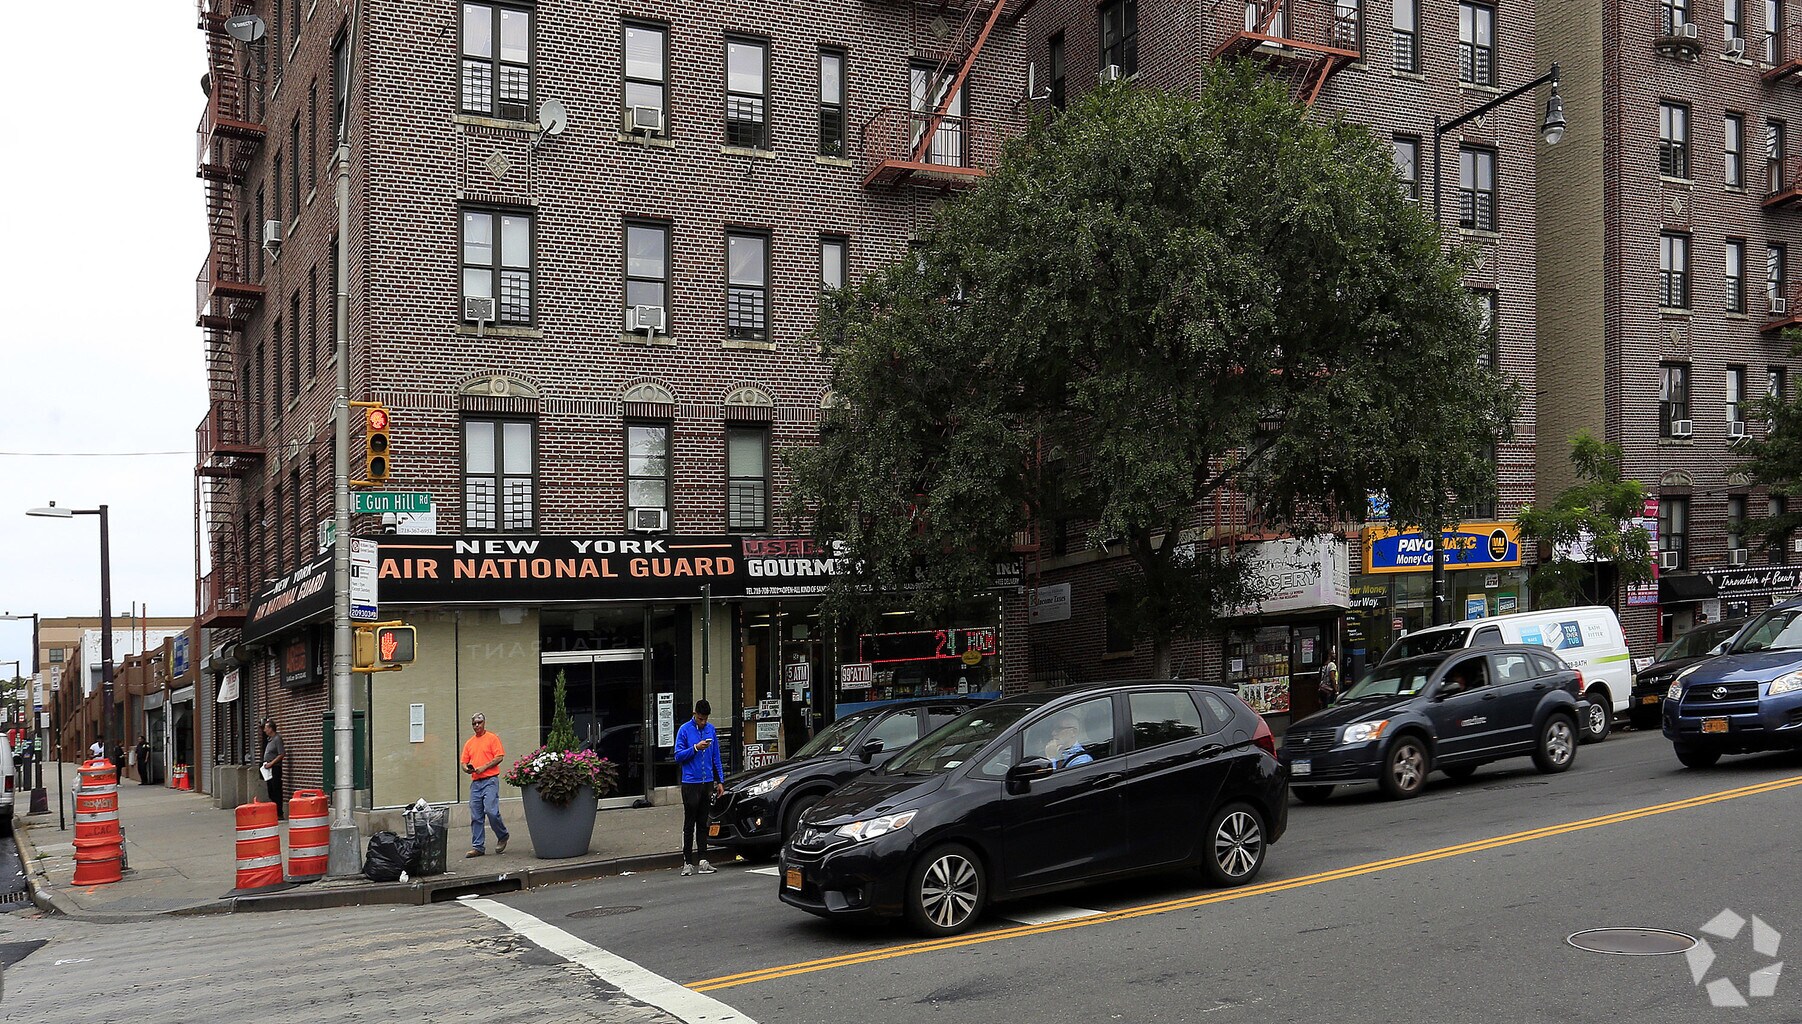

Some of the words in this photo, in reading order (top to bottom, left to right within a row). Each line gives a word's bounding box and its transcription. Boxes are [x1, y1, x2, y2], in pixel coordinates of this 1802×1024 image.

[355, 493, 361, 510] E
[366, 495, 389, 510] Gun
[394, 494, 415, 510] Hill
[419, 496, 428, 505] Rd
[455, 540, 540, 554] NEW
[570, 540, 667, 554] YORK
[748, 558, 865, 576] GOURM
[1396, 553, 1421, 566] Money
[1422, 552, 1450, 564] Cers
[378, 558, 439, 579] AIR
[453, 558, 619, 579] NATIONAL
[629, 557, 735, 577] GUARD
[273, 576, 290, 594] NEW
[293, 563, 313, 584] YORK
[1718, 573, 1759, 589] Innovation
[1761, 571, 1772, 587] of
[1772, 570, 1796, 586] Beauty
[253, 603, 267, 622] AIR
[264, 586, 298, 617] NATIONAL
[297, 571, 327, 601] GUARD
[1349, 586, 1361, 595] our
[1349, 599, 1361, 607] our
[1362, 597, 1379, 608] Way.
[1563, 625, 1577, 633] TUB
[935, 628, 956, 658] 24
[1567, 637, 1580, 645] TUB
[853, 666, 870, 682] ATM
[750, 756, 761, 768] $5
